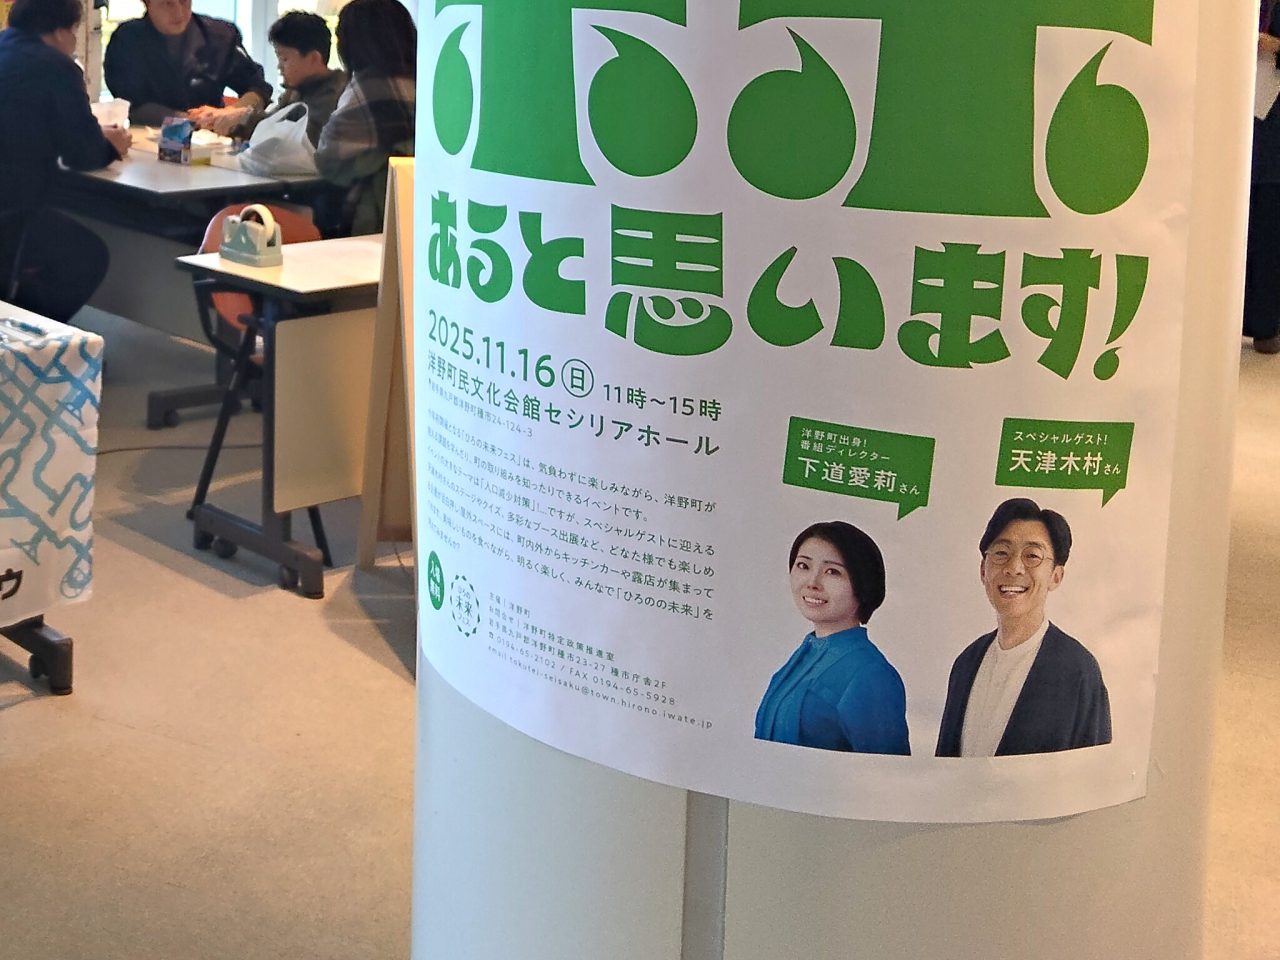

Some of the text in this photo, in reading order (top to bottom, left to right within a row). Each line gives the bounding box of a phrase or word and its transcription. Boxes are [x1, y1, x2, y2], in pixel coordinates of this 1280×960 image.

[428, 189, 1150, 381] あると思います!
